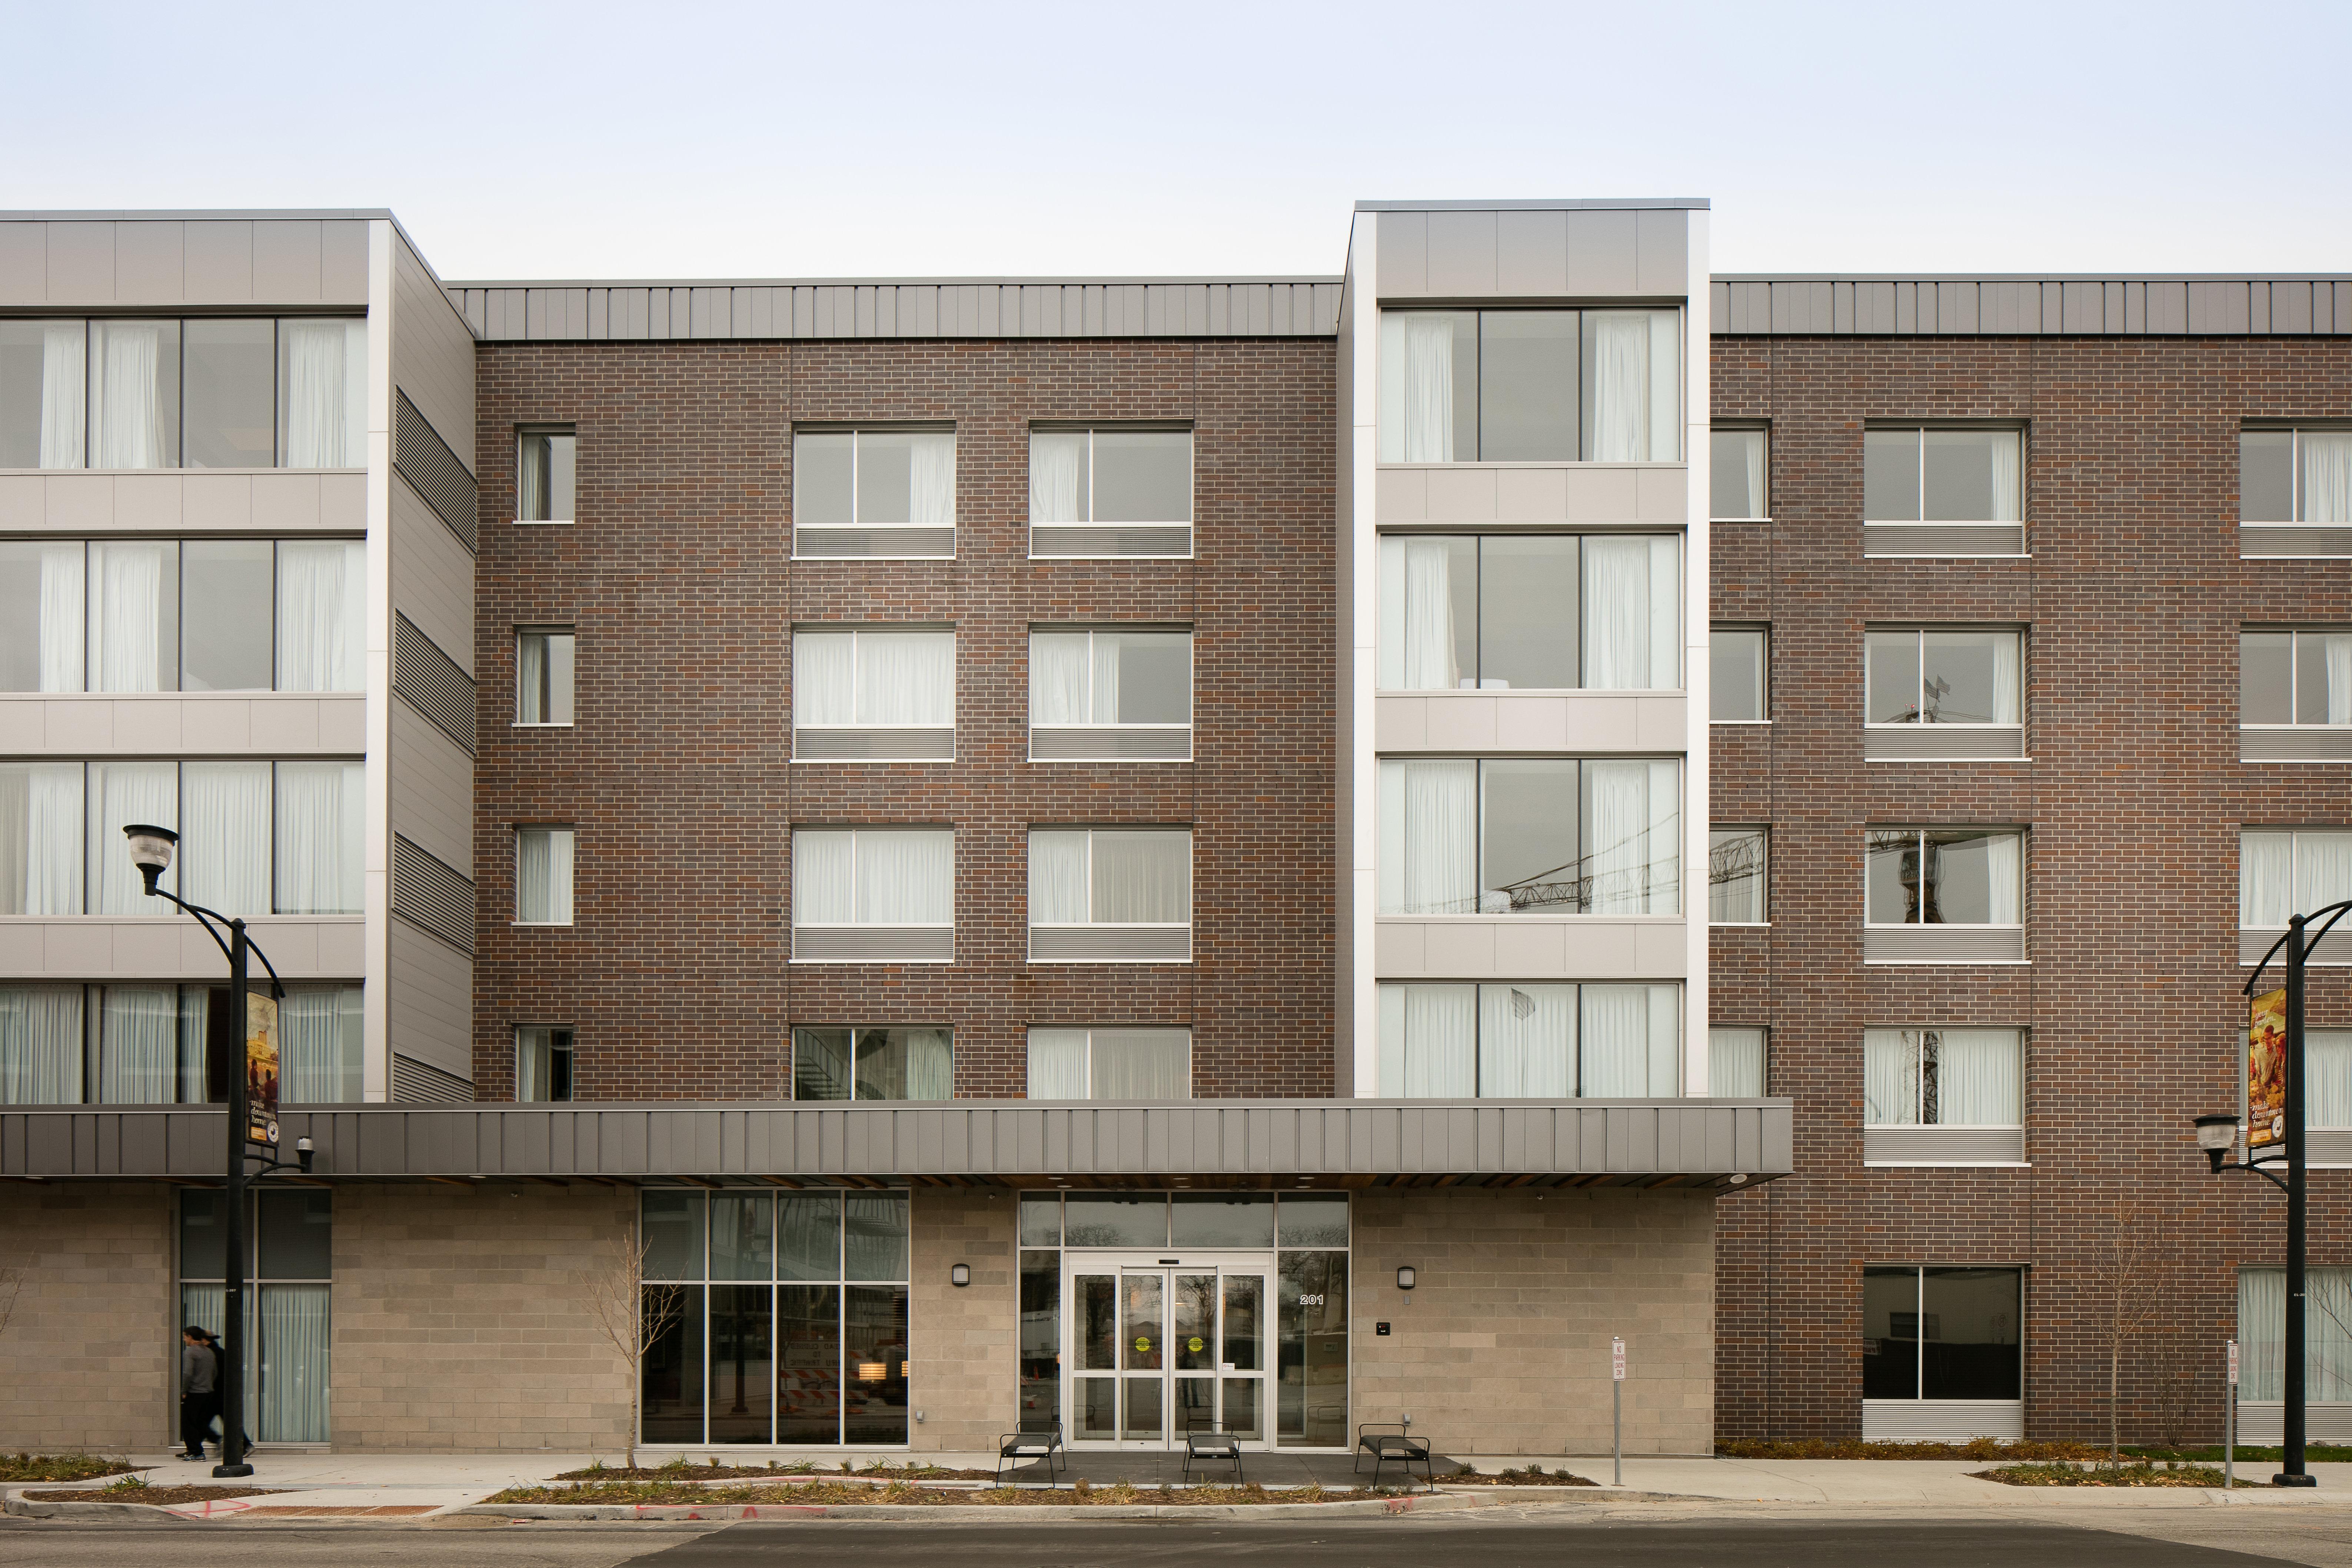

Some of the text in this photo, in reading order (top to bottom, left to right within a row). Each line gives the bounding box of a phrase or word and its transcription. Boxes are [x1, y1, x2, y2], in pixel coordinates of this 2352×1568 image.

[2255, 1009, 2268, 1020] your
[249, 1100, 265, 1109] make
[2250, 1101, 2269, 1111] make
[251, 1107, 276, 1120] downtown
[2252, 1108, 2283, 1119] downtown
[2253, 1119, 2271, 1128] home.
[1300, 1295, 1323, 1304] 201
